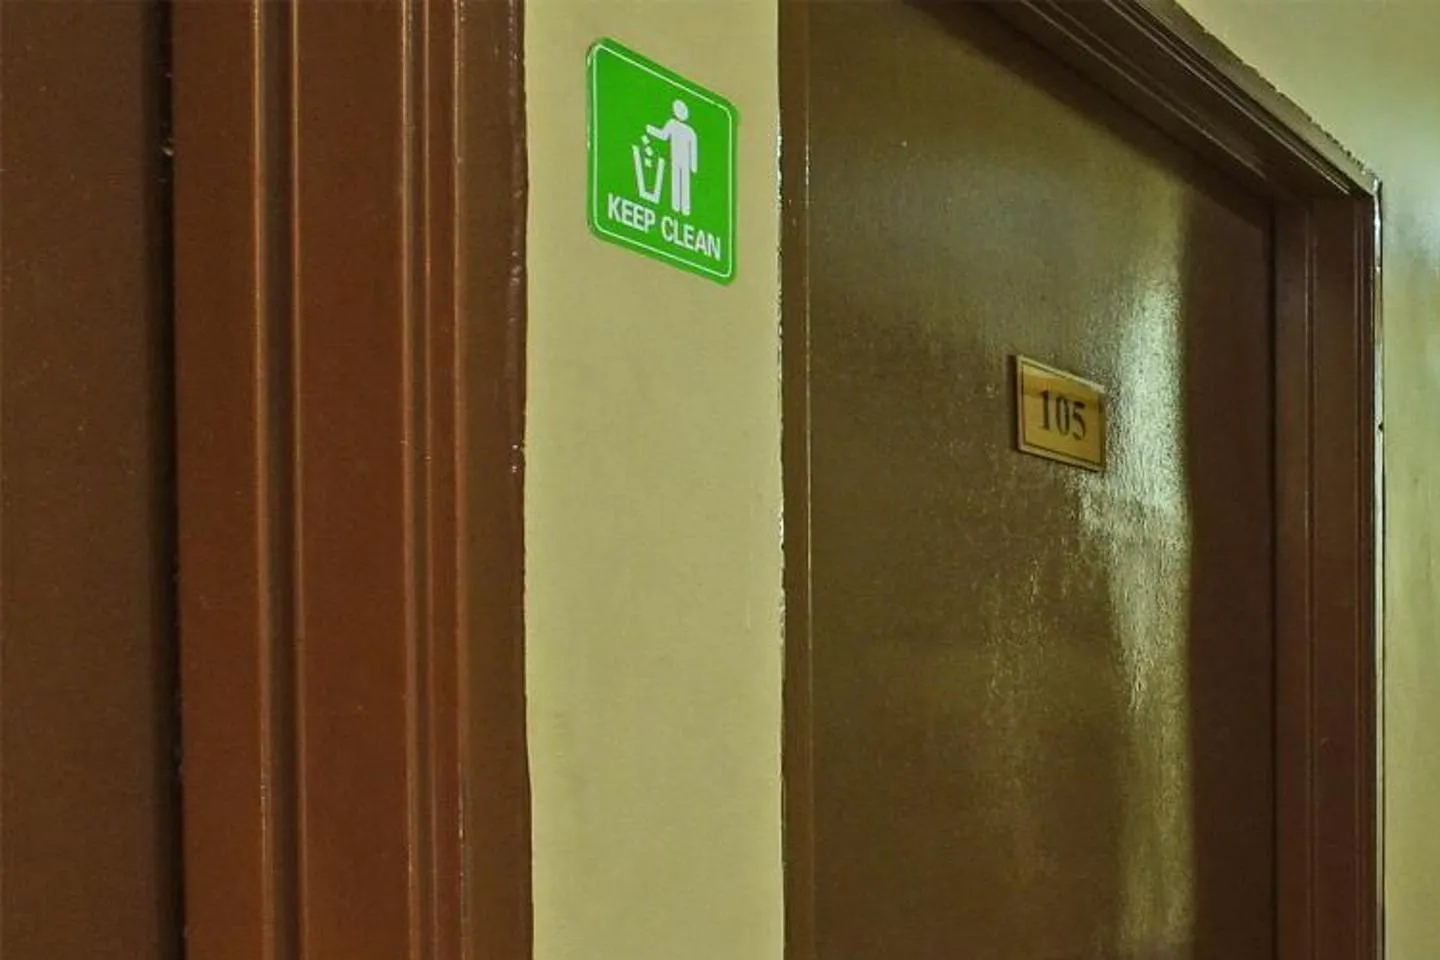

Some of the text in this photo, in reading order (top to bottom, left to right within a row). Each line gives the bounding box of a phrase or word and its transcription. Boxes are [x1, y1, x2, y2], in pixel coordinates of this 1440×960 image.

[608, 193, 721, 261] KEEP CLEAN
[1039, 390, 1086, 441] 105
